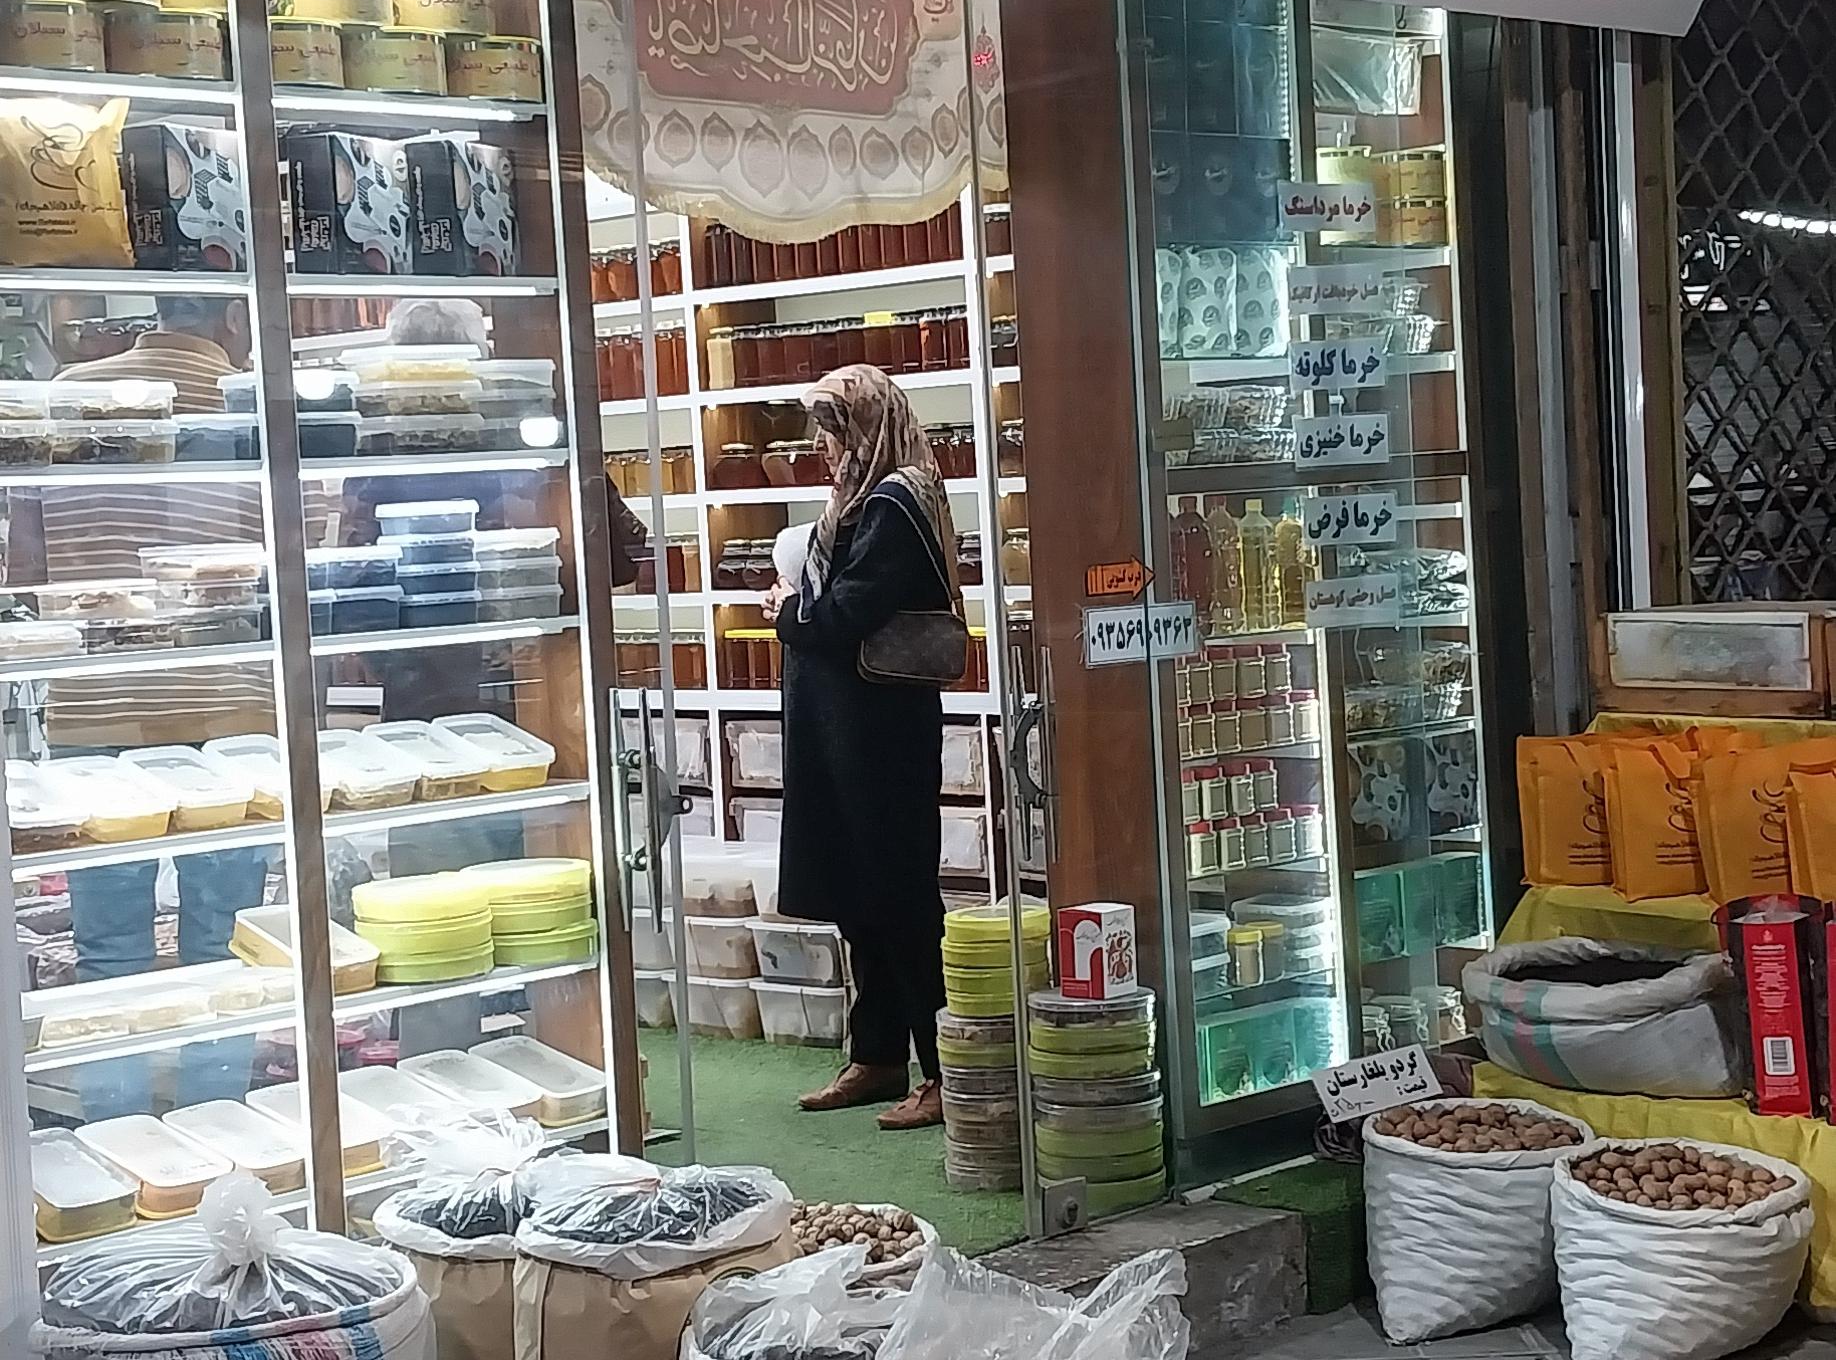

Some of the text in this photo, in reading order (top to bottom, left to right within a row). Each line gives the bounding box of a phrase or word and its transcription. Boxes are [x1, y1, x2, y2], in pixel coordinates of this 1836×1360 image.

[1343, 195, 1371, 222] خرما
[1340, 346, 1380, 383] خرما
[1349, 422, 1384, 455] خرما
[1353, 500, 1392, 536] خرما
[1327, 1050, 1417, 1097] گردو بلغارستان
